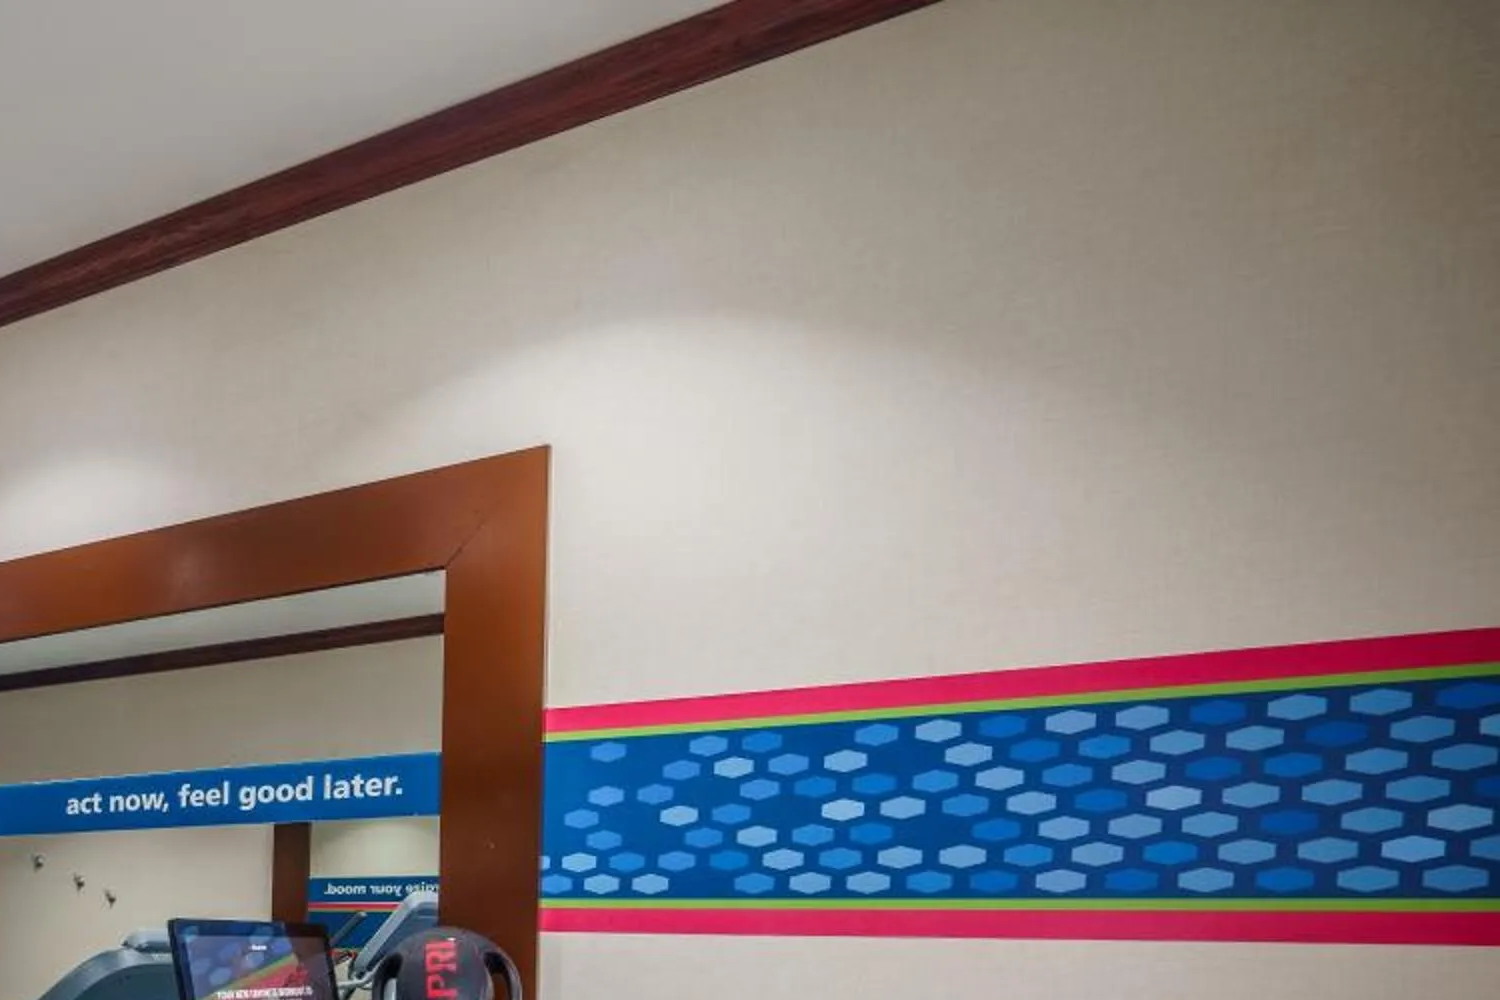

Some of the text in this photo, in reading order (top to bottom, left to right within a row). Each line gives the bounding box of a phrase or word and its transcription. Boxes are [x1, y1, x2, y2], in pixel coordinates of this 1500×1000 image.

[65, 773, 403, 815] act now, feel good later.
